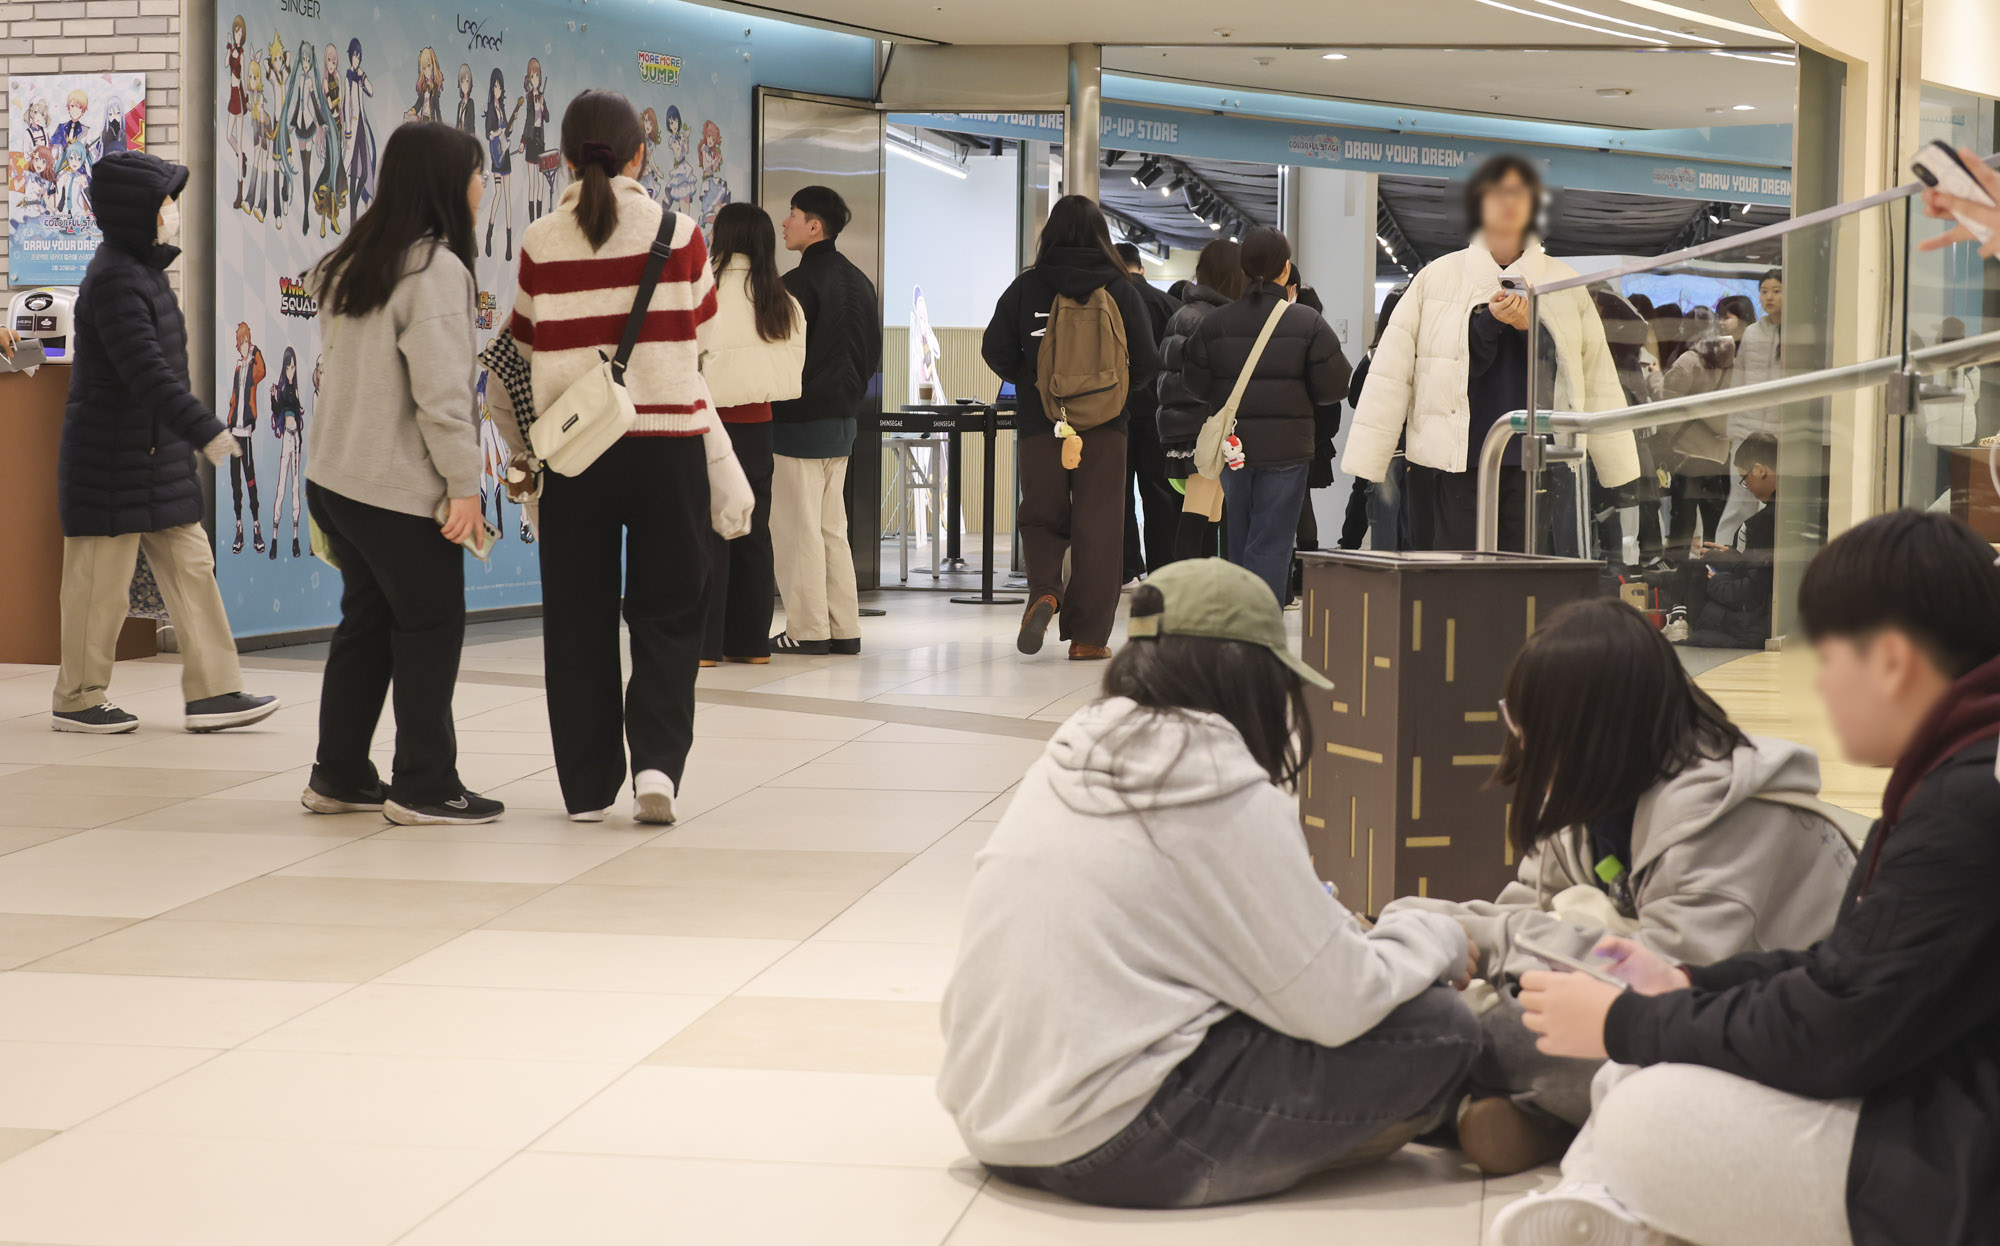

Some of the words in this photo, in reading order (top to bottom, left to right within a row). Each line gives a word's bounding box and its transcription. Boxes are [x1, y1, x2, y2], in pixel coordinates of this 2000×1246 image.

[281, 0, 321, 19] SINGER
[641, 65, 678, 85] JUMP!
[1137, 119, 1178, 142] STORE
[1344, 140, 1383, 161] DRAW
[1385, 143, 1419, 165] YOUR
[1421, 146, 1465, 168] DREAM
[1698, 172, 1731, 191] DRAW
[1731, 175, 1759, 194] YOUR
[44, 219, 81, 227] COLORFUL
[24, 240, 50, 251] DRAW
[52, 240, 76, 251] YOUR
[281, 296, 318, 312] SQUAD
[879, 419, 903, 427] SHINSEGAE
